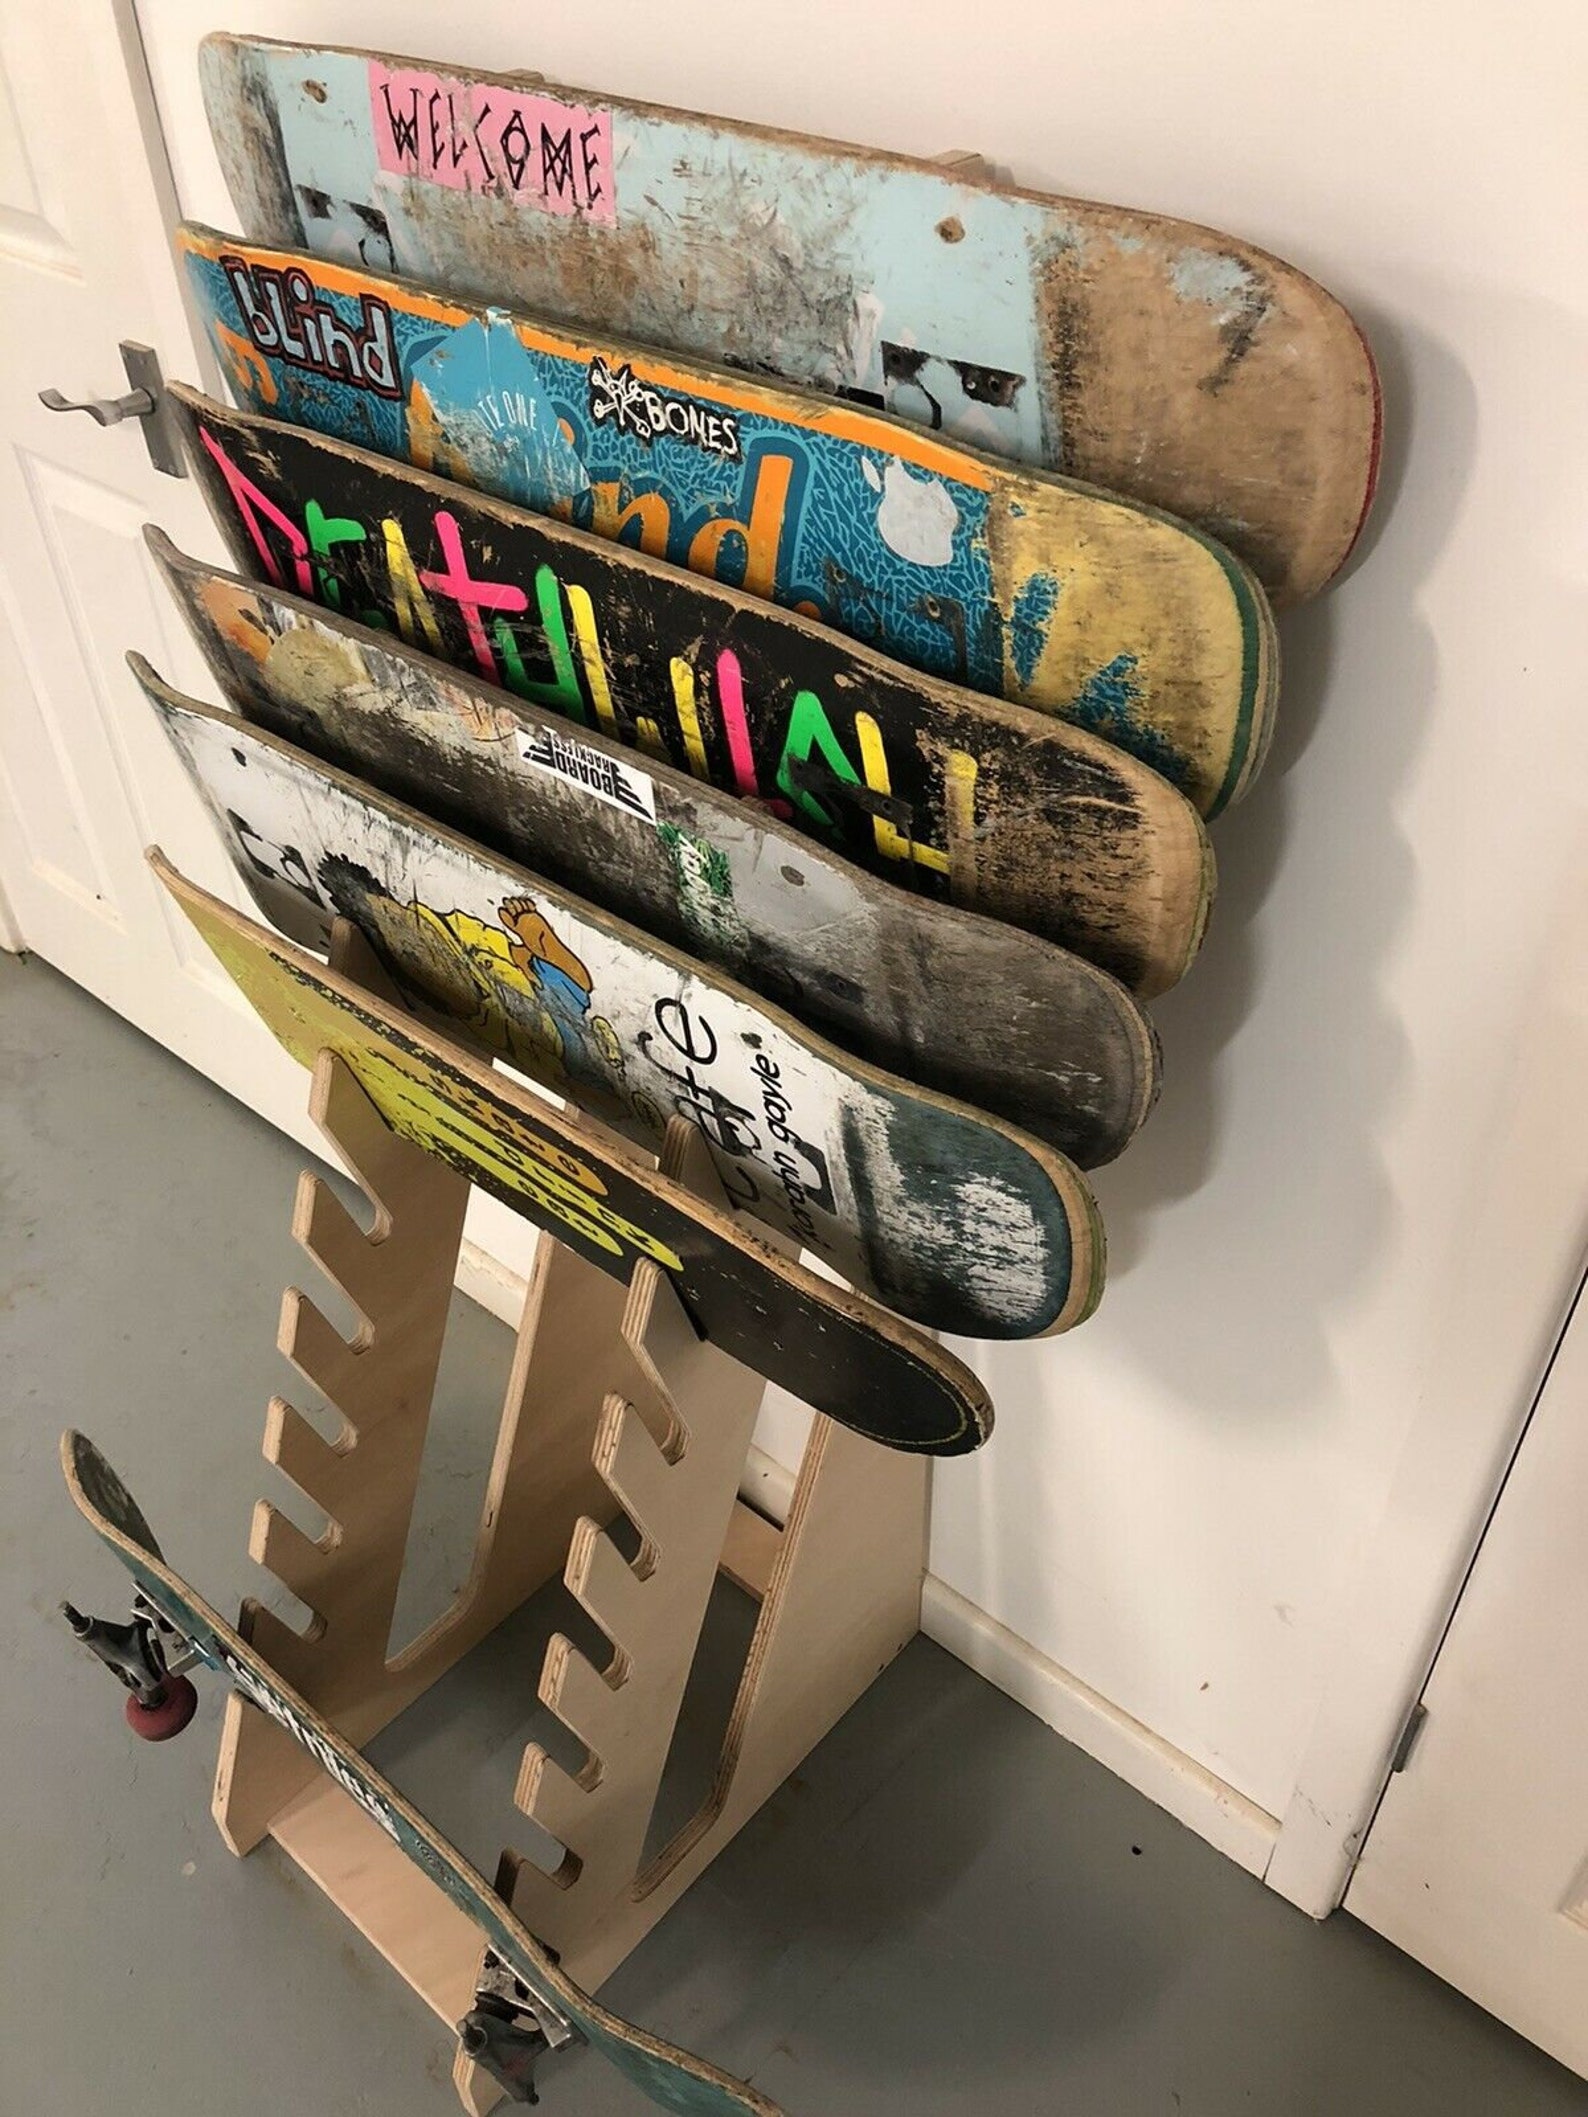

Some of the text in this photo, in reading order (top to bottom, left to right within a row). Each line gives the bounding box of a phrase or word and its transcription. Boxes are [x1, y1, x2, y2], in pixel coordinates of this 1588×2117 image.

[380, 83, 603, 211] WELCOME
[643, 391, 739, 455] BONES
[555, 750, 614, 797] BOARD
[750, 1053, 801, 1146] gayle
[493, 1137, 657, 1253] drink
[517, 1179, 601, 1238] eat
